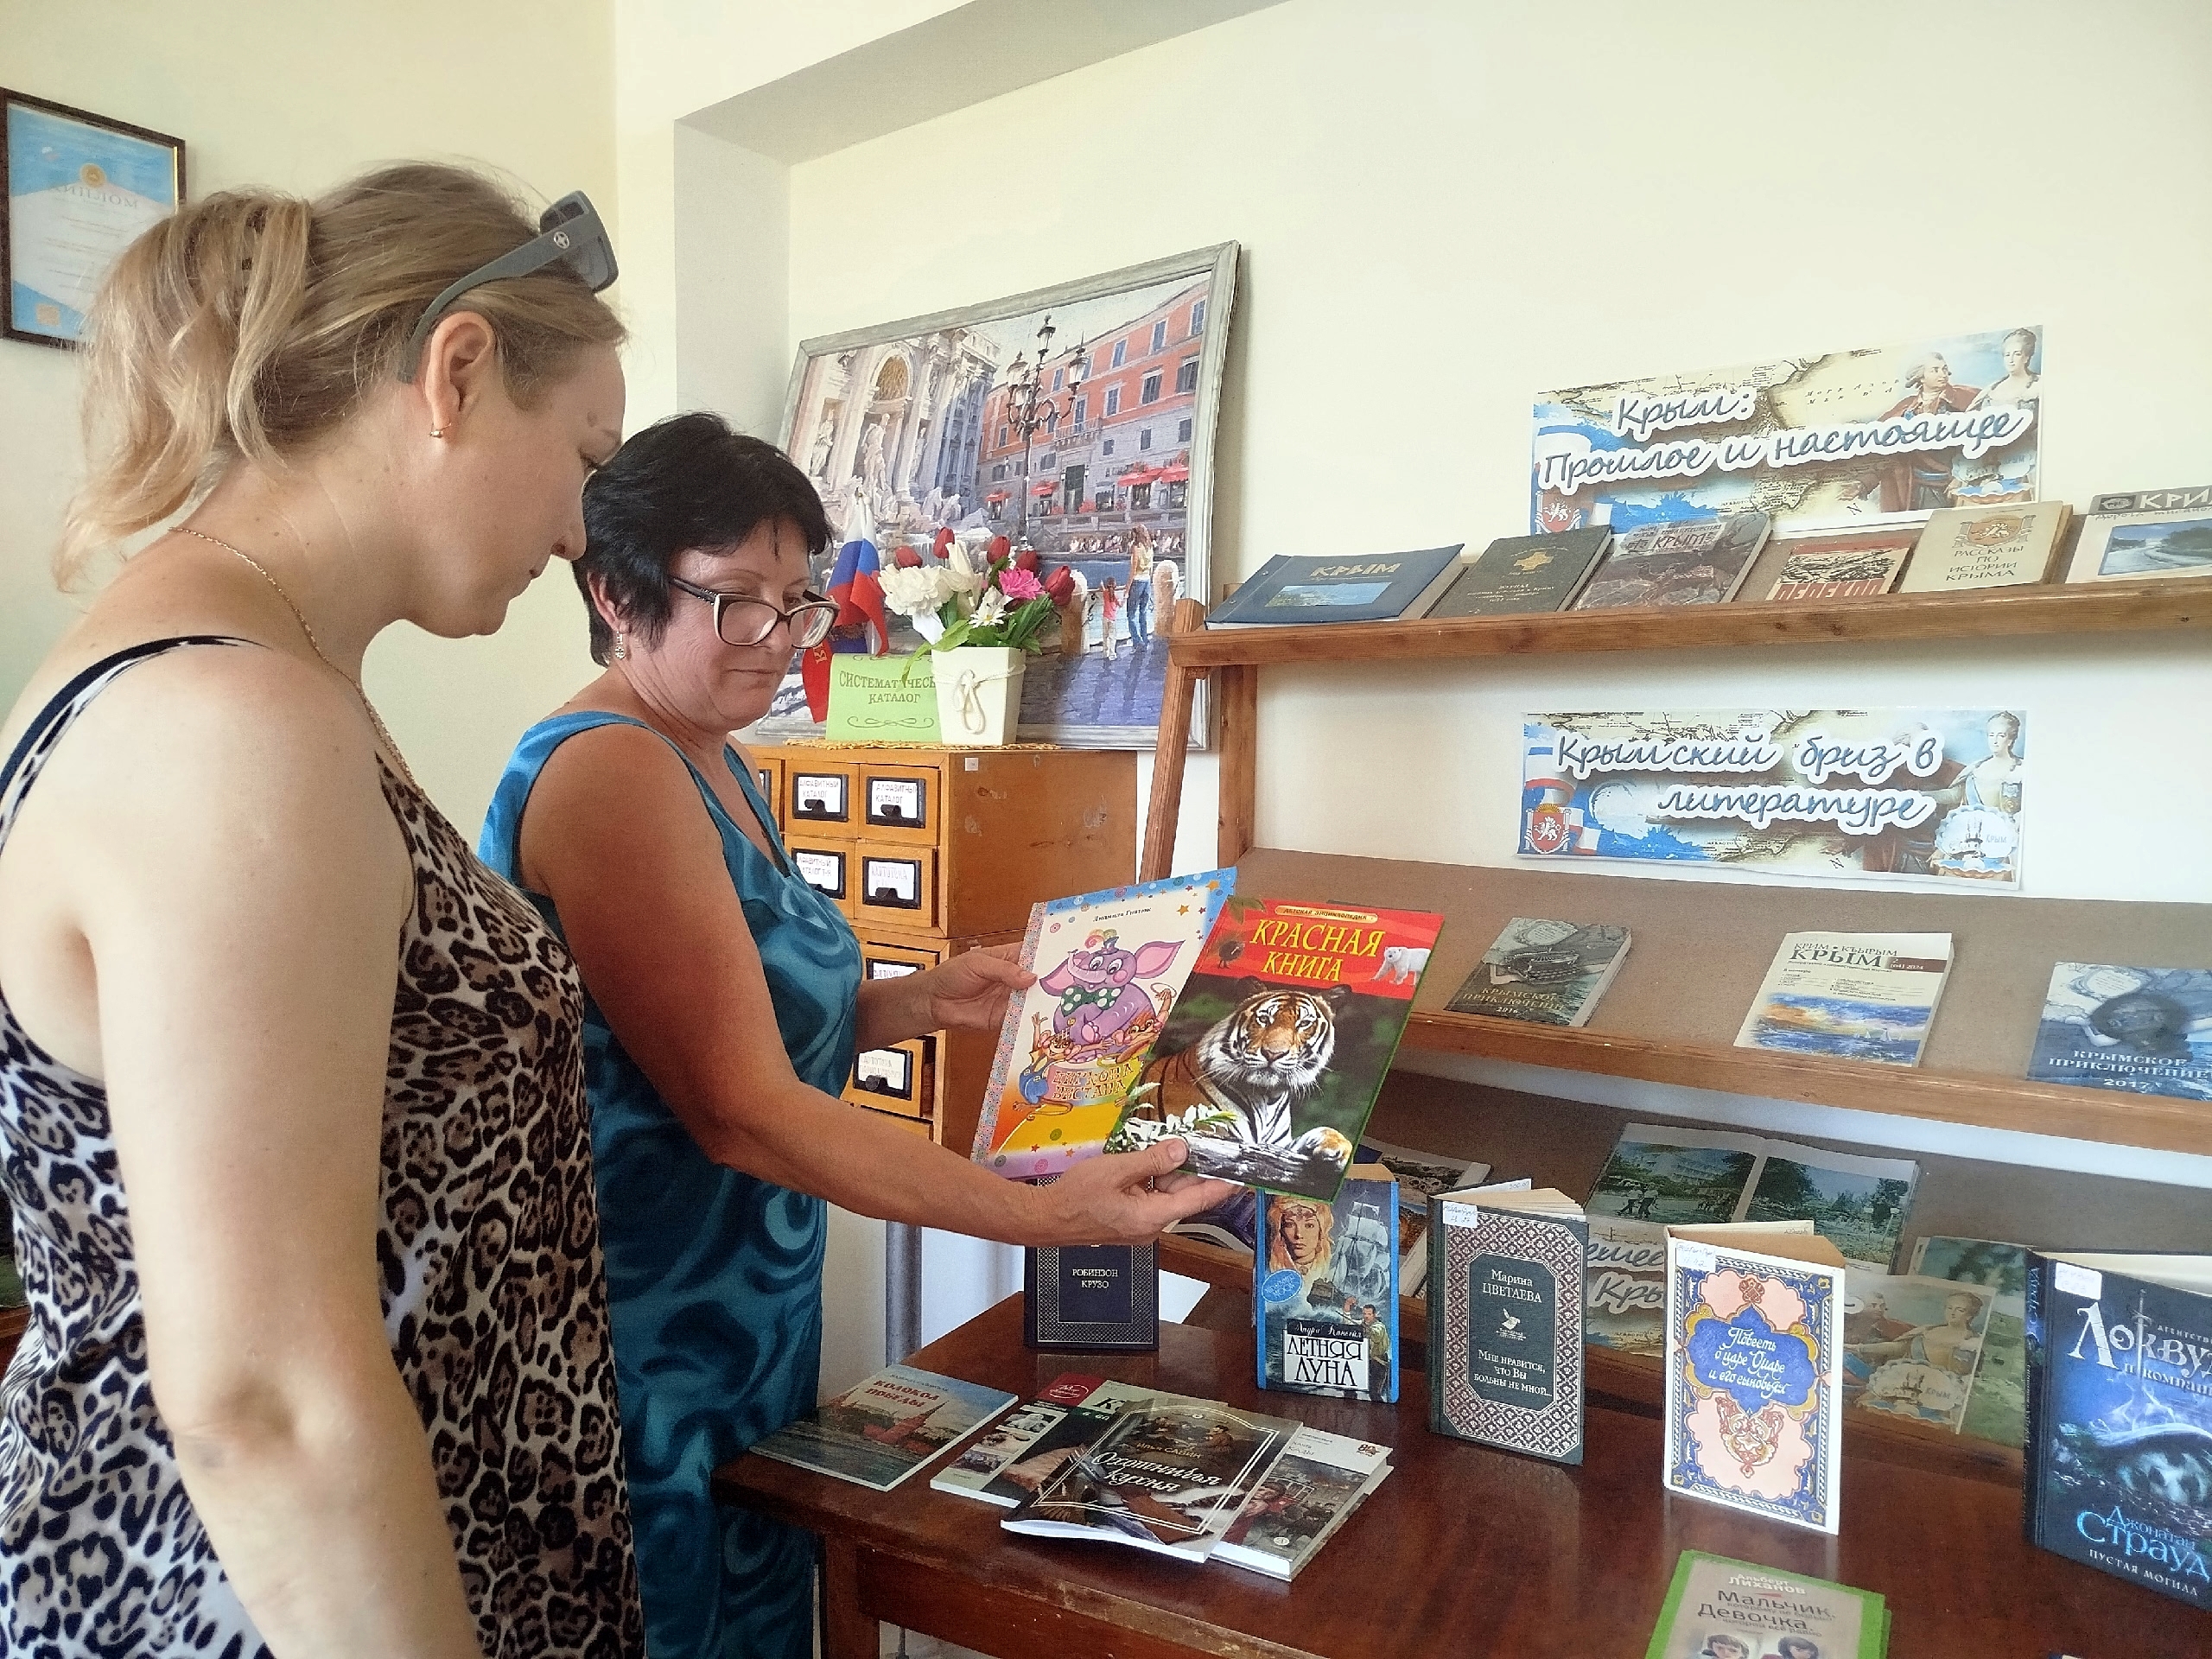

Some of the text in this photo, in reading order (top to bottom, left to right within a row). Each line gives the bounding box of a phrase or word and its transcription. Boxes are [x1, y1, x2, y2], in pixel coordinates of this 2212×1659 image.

[1618, 393, 1751, 433] Крым:
[1544, 412, 2024, 484] Прошлое и настоящее
[2139, 486, 2212, 510] КРИ
[1954, 545, 2024, 557] РАССКАЗЫ
[1309, 563, 1402, 577] КРЫМ
[1945, 569, 2015, 582] КРЫМА
[1949, 562, 2018, 573] ИСТОРИИ
[868, 693, 922, 705] КАТАЛОГ
[1559, 733, 1936, 777] Крымский бриз в
[1657, 788, 1926, 828] литературе
[1249, 918, 1386, 958] КРАСНАЯ
[1260, 950, 1344, 982] КНИГА
[1789, 949, 1882, 968] КРЫМ
[2073, 1050, 2188, 1066] КРЫМСКОЕ
[2103, 1078, 2152, 1088] 2017
[1071, 1268, 1118, 1278] РОБИНЗОН
[1491, 1268, 1534, 1287] Марина
[1081, 1280, 1109, 1288] КРУЗО
[1482, 1282, 1542, 1304] ЦВЕТАЕВА
[1287, 1336, 1363, 1361] ЛЕТНЯЯ
[1727, 1326, 1777, 1351] Повесть
[1714, 1350, 1722, 1359] о
[1721, 1351, 1748, 1370] царе
[1294, 1356, 1358, 1387] ЛУНА
[1708, 1370, 1718, 1380] и
[1719, 1370, 1738, 1383] его
[865, 1388, 926, 1408] ПОБЕДЫ
[873, 1380, 940, 1401] КОЛОКОЛ
[1163, 1446, 1202, 1459] САВИН
[1091, 1452, 1223, 1486] Охотничья
[2106, 1506, 2196, 1550] Джонатан
[2076, 1510, 2210, 1584] Страуд
[1737, 1573, 1789, 1586] Альберт
[2089, 1548, 2197, 1596] ПУСТАЯ МОГИЛА
[1728, 1576, 1807, 1595] Лиханов
